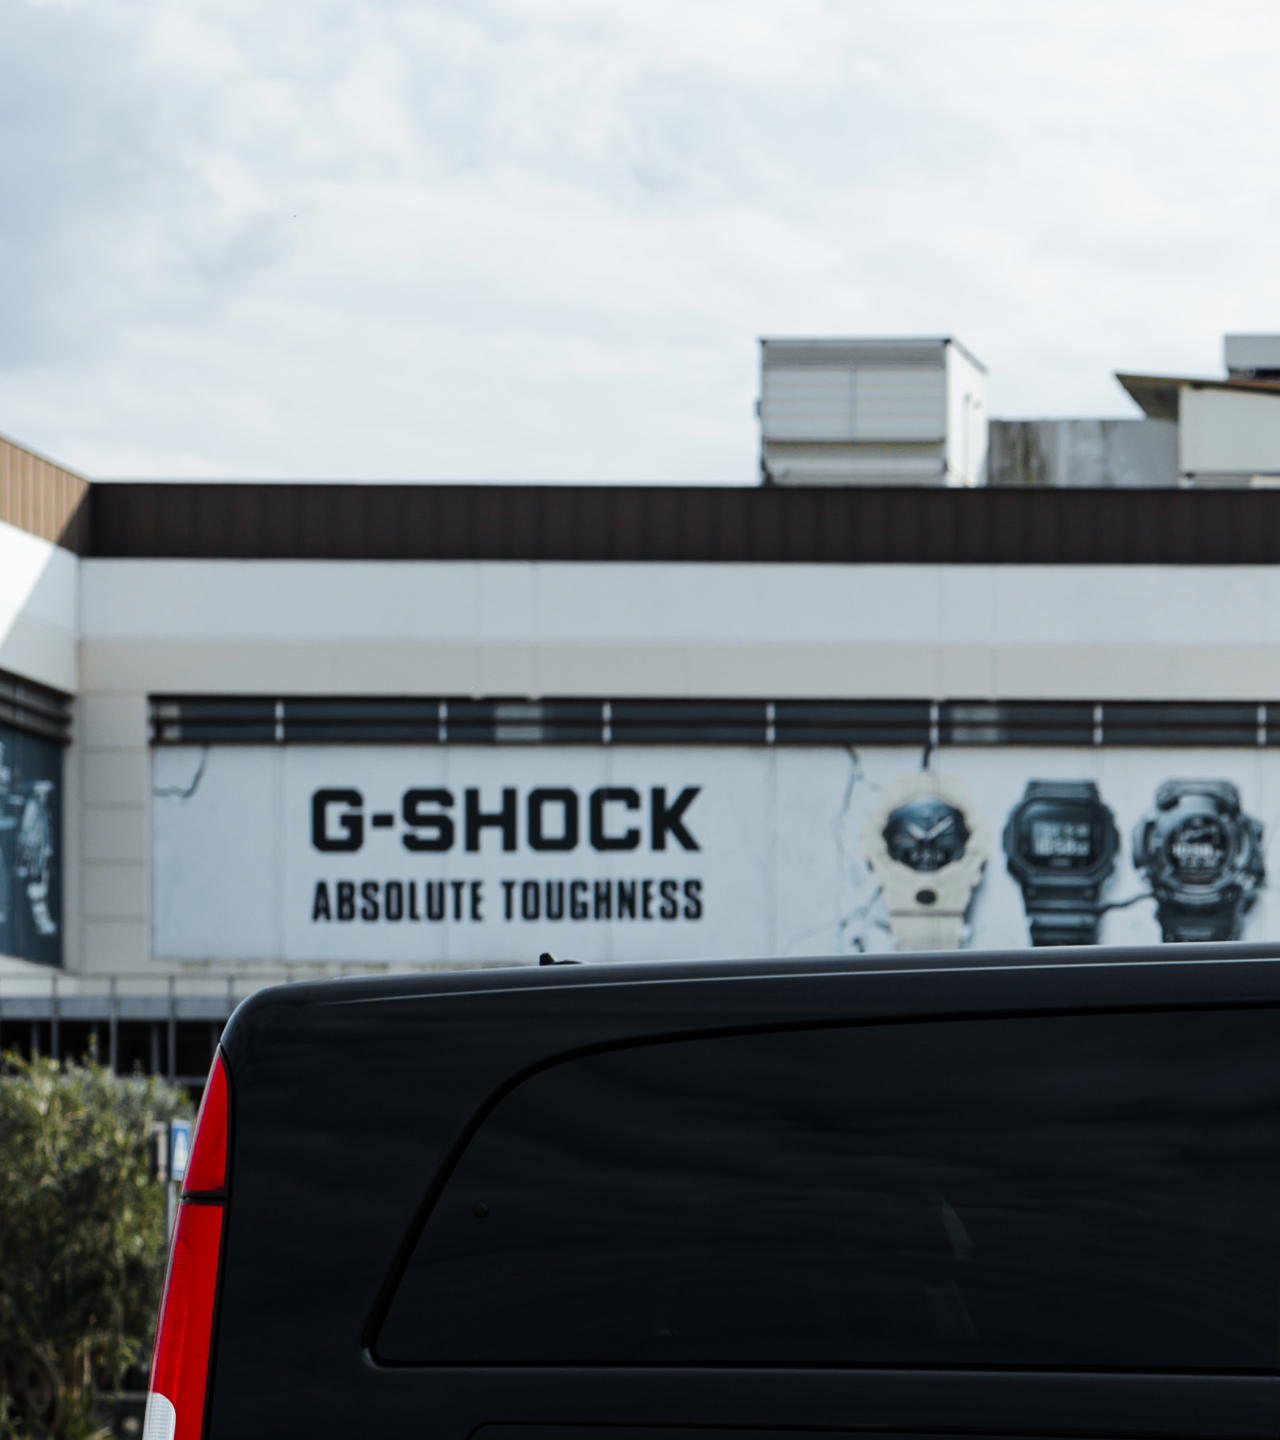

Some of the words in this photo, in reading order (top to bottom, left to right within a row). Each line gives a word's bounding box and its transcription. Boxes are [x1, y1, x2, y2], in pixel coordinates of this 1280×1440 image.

[311, 786, 702, 854] G-SHOCK
[311, 880, 484, 923] ABSOLUTE
[500, 879, 703, 922] TOUGHNESS
